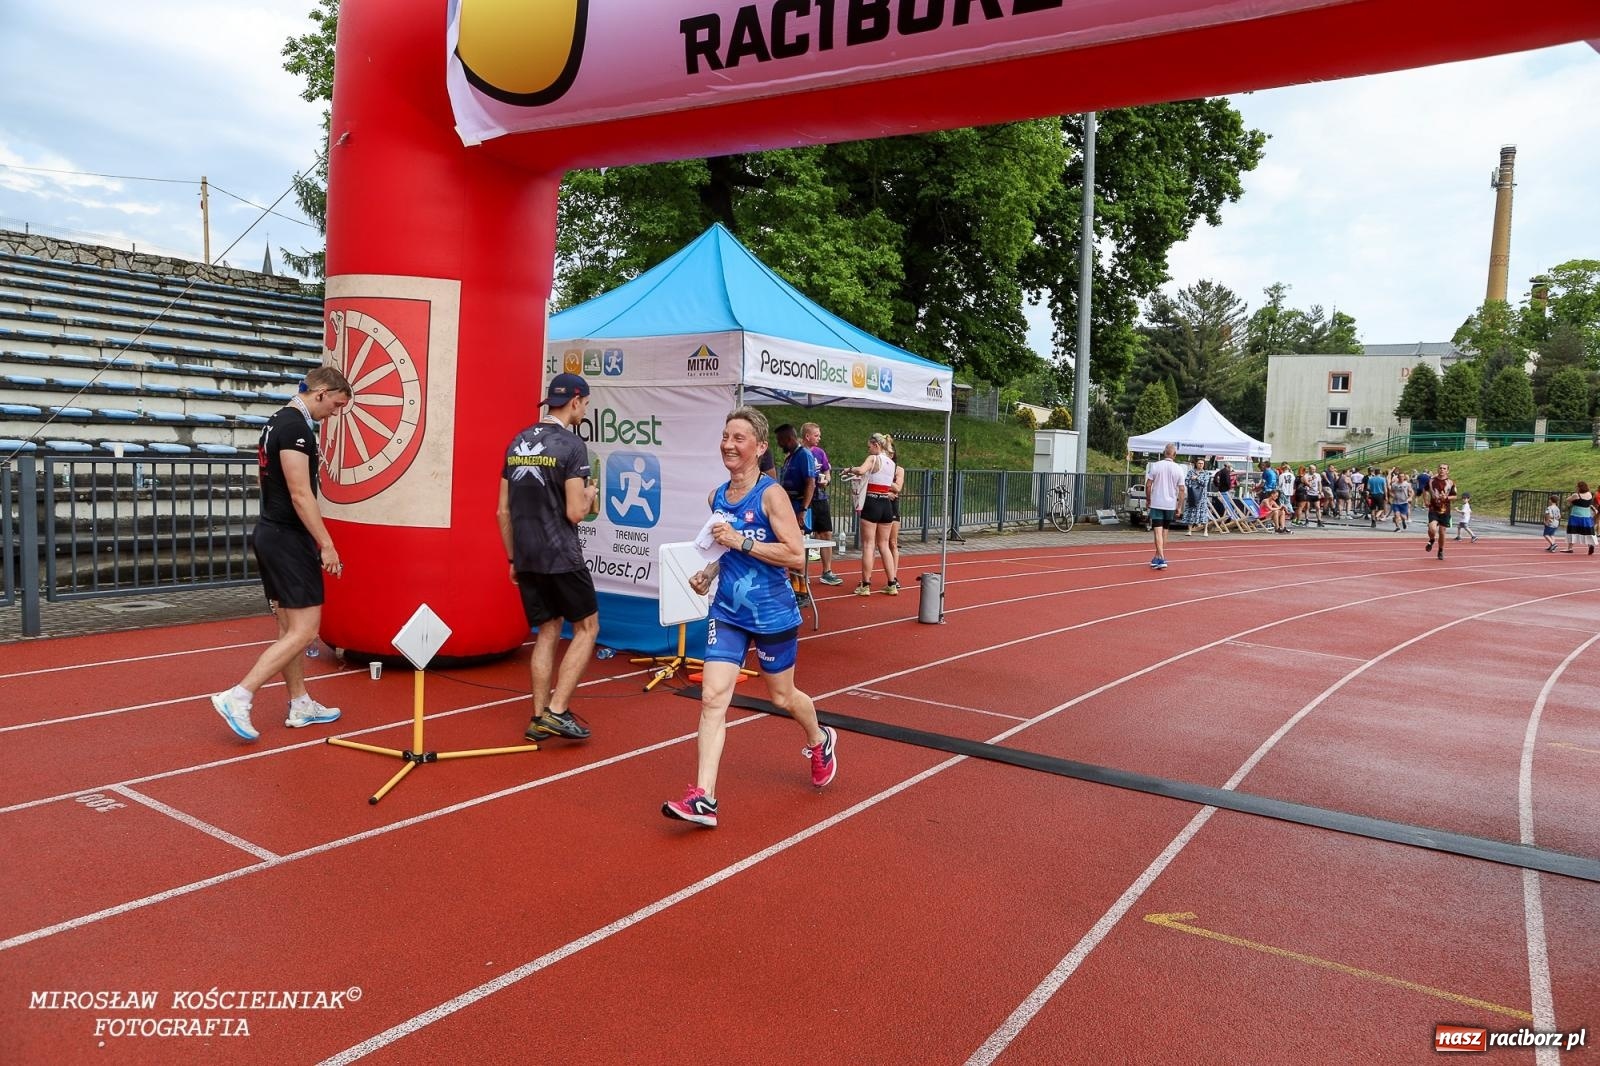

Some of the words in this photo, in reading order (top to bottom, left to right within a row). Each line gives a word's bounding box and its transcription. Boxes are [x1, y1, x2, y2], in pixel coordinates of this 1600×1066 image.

[687, 358, 719, 371] MITKO
[760, 349, 848, 384] PersonalBest
[615, 529, 649, 543] TRENINGI
[613, 543, 650, 556] BIEGOWE
[585, 555, 652, 585] albest.pl
